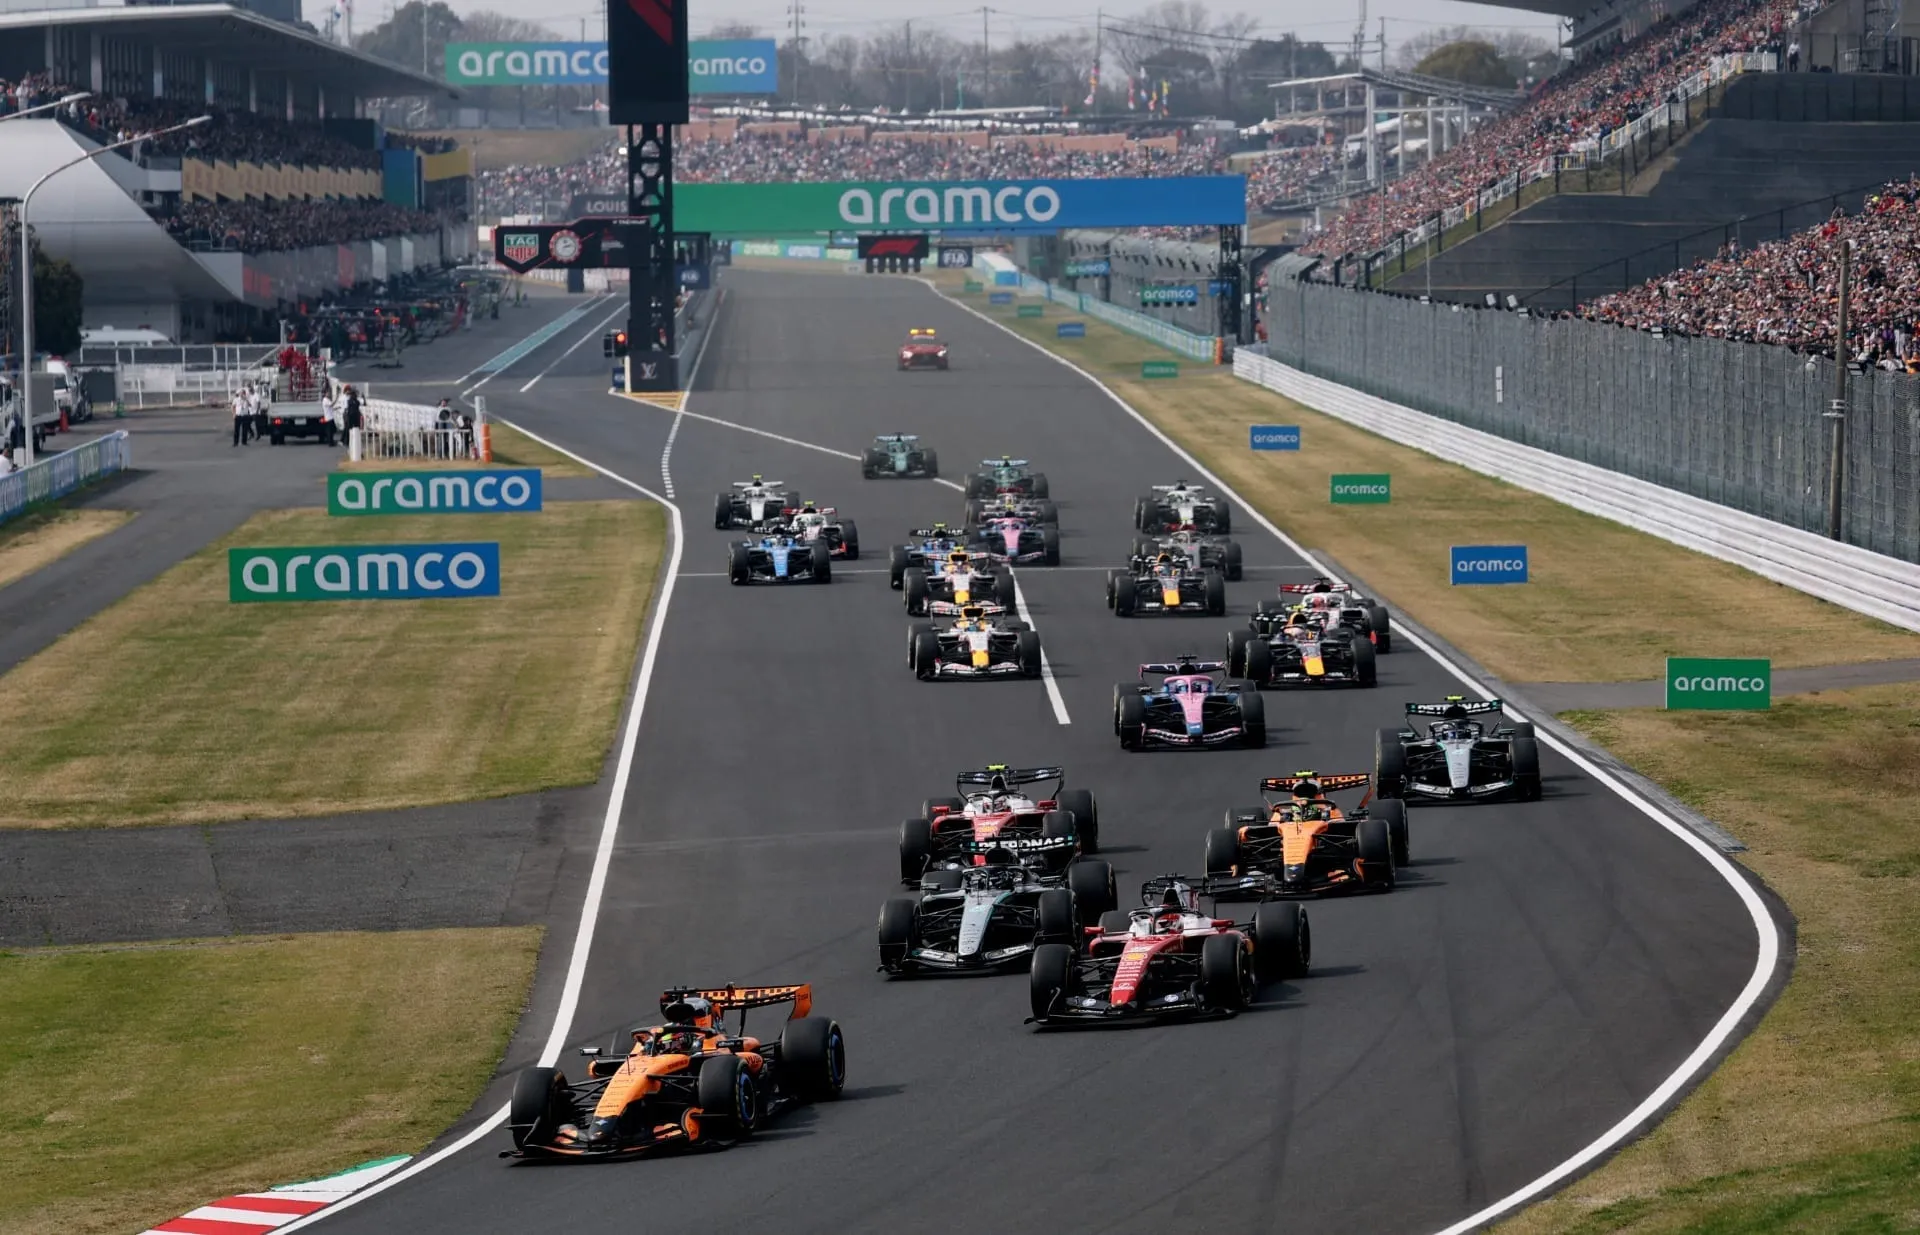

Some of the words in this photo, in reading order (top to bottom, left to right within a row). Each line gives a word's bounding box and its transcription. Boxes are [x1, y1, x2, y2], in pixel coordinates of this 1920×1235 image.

[587, 200, 629, 213] LOUIS
[839, 186, 1060, 224] aramco
[508, 237, 536, 246] TAG
[943, 251, 968, 265] FIA
[1144, 289, 1194, 299] aramco
[1253, 433, 1298, 443] aramco
[338, 476, 531, 508] aramco
[1334, 484, 1388, 494] aramco
[243, 552, 485, 593] aramco
[1457, 560, 1523, 572] aramco
[1675, 676, 1764, 692] aramco
